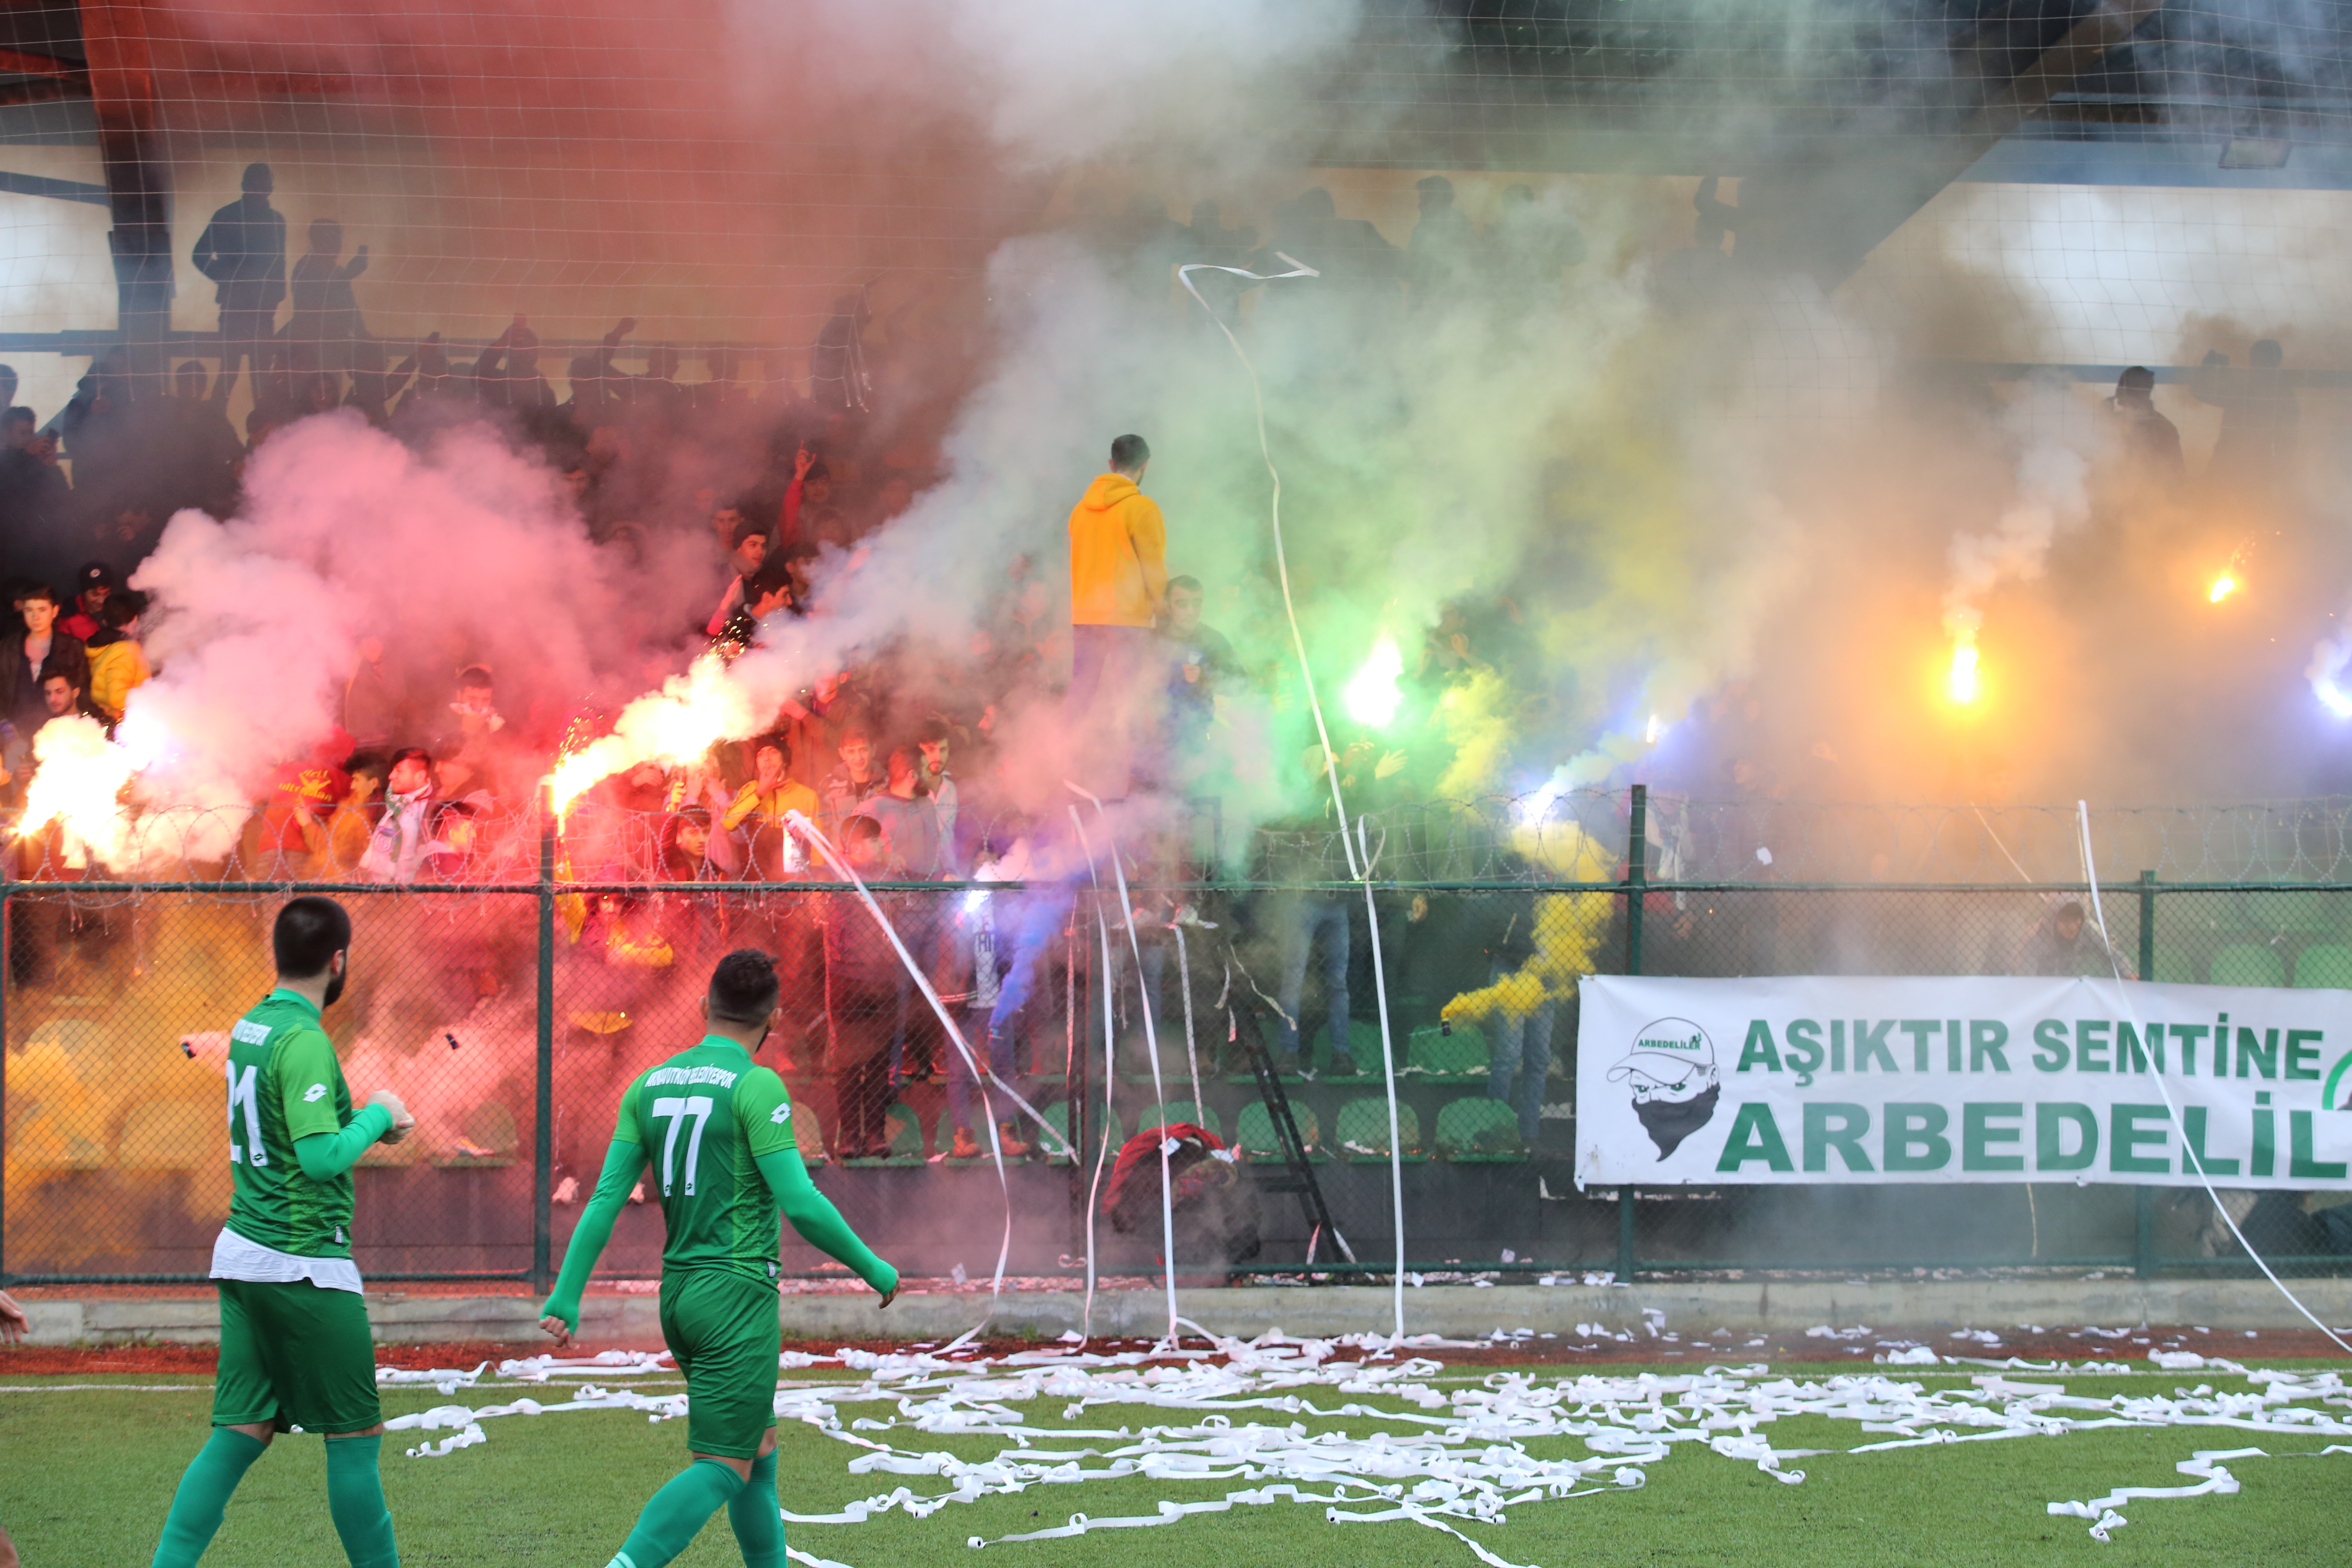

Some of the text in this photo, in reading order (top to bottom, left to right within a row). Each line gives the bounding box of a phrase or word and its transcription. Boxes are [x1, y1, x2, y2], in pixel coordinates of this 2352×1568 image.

[1638, 1039, 1700, 1050] ARBEDELİLER
[1736, 1012, 2324, 1086] AŞIKTIR SEMTİNE
[652, 1096, 714, 1197] 77
[1715, 1090, 2348, 1178] ARBEDELİL
